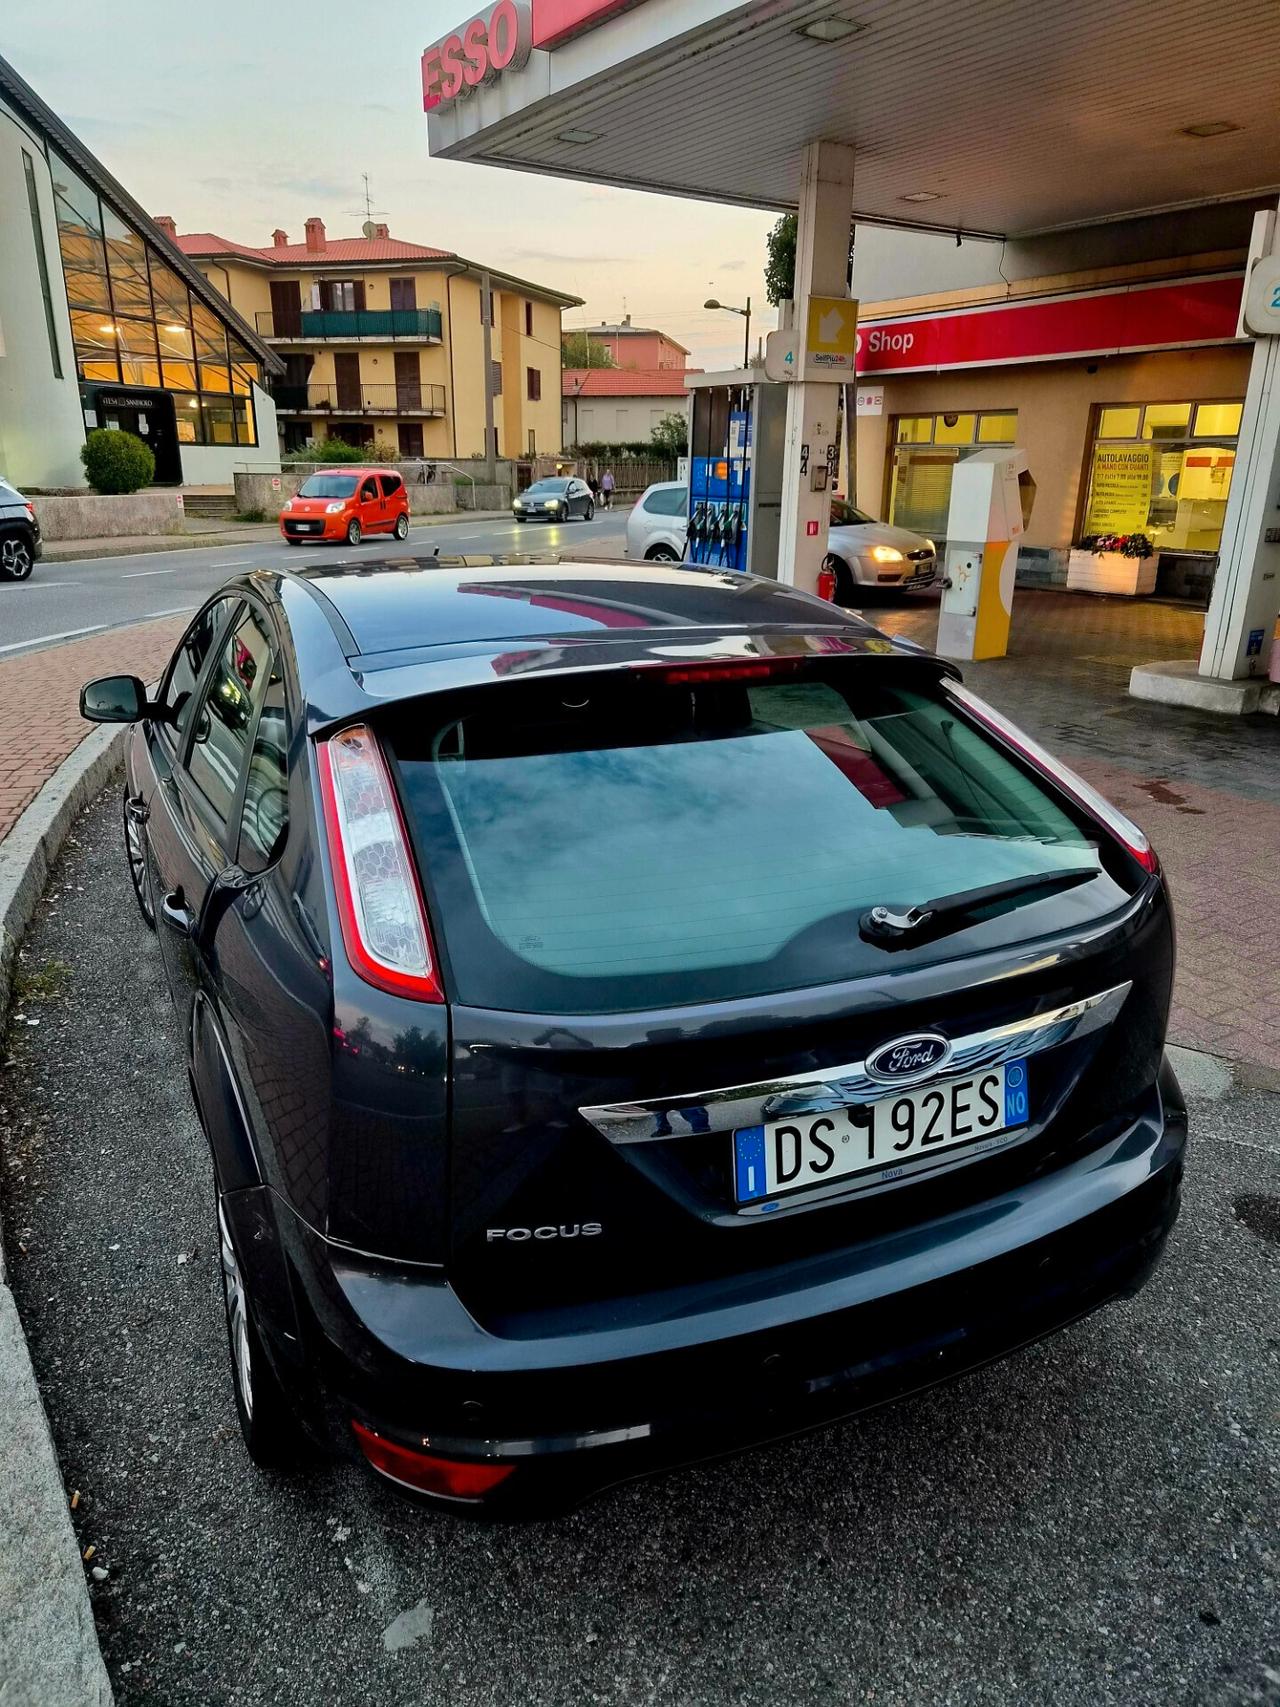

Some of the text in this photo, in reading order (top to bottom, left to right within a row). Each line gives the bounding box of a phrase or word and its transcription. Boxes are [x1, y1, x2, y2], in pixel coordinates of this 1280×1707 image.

[421, 0, 518, 112] ESSO
[868, 330, 914, 354] Shop
[784, 351, 794, 364] 4
[801, 446, 809, 459] 4
[828, 446, 835, 459] 3
[1097, 453, 1149, 463] AUTOLAVAGGIO
[800, 460, 807, 476] 4
[888, 1042, 934, 1072] Ford
[1006, 1092, 1026, 1117] NO
[486, 1222, 602, 1241] FOCUS
